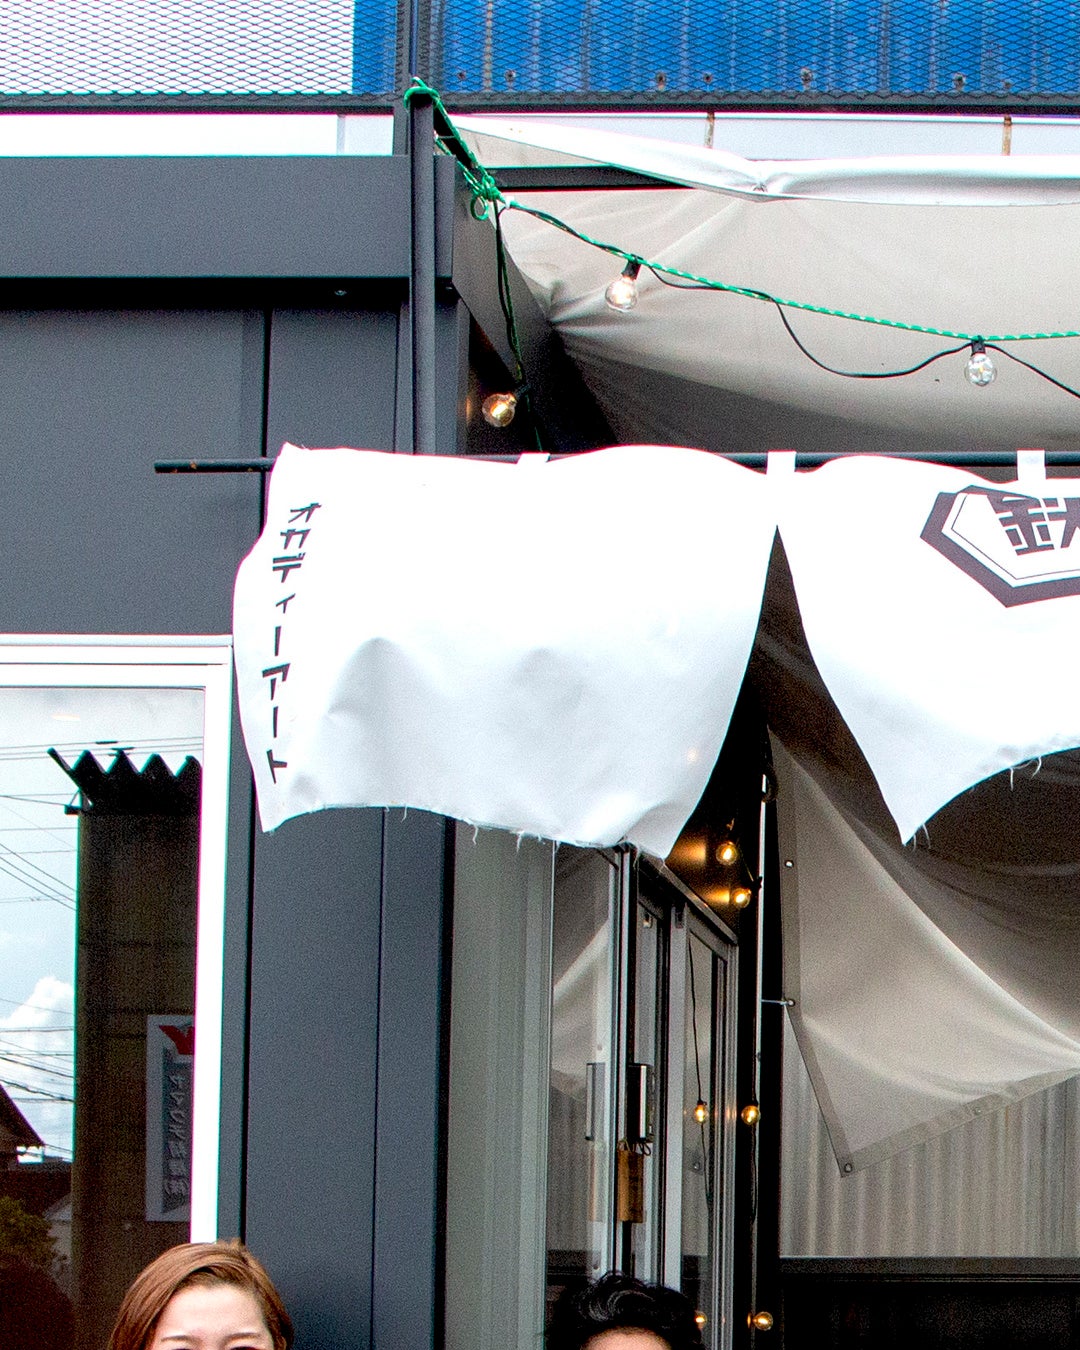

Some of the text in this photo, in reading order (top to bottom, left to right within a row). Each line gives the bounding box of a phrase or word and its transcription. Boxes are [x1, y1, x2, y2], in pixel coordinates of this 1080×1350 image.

[262, 502, 322, 785] オカディーアート
